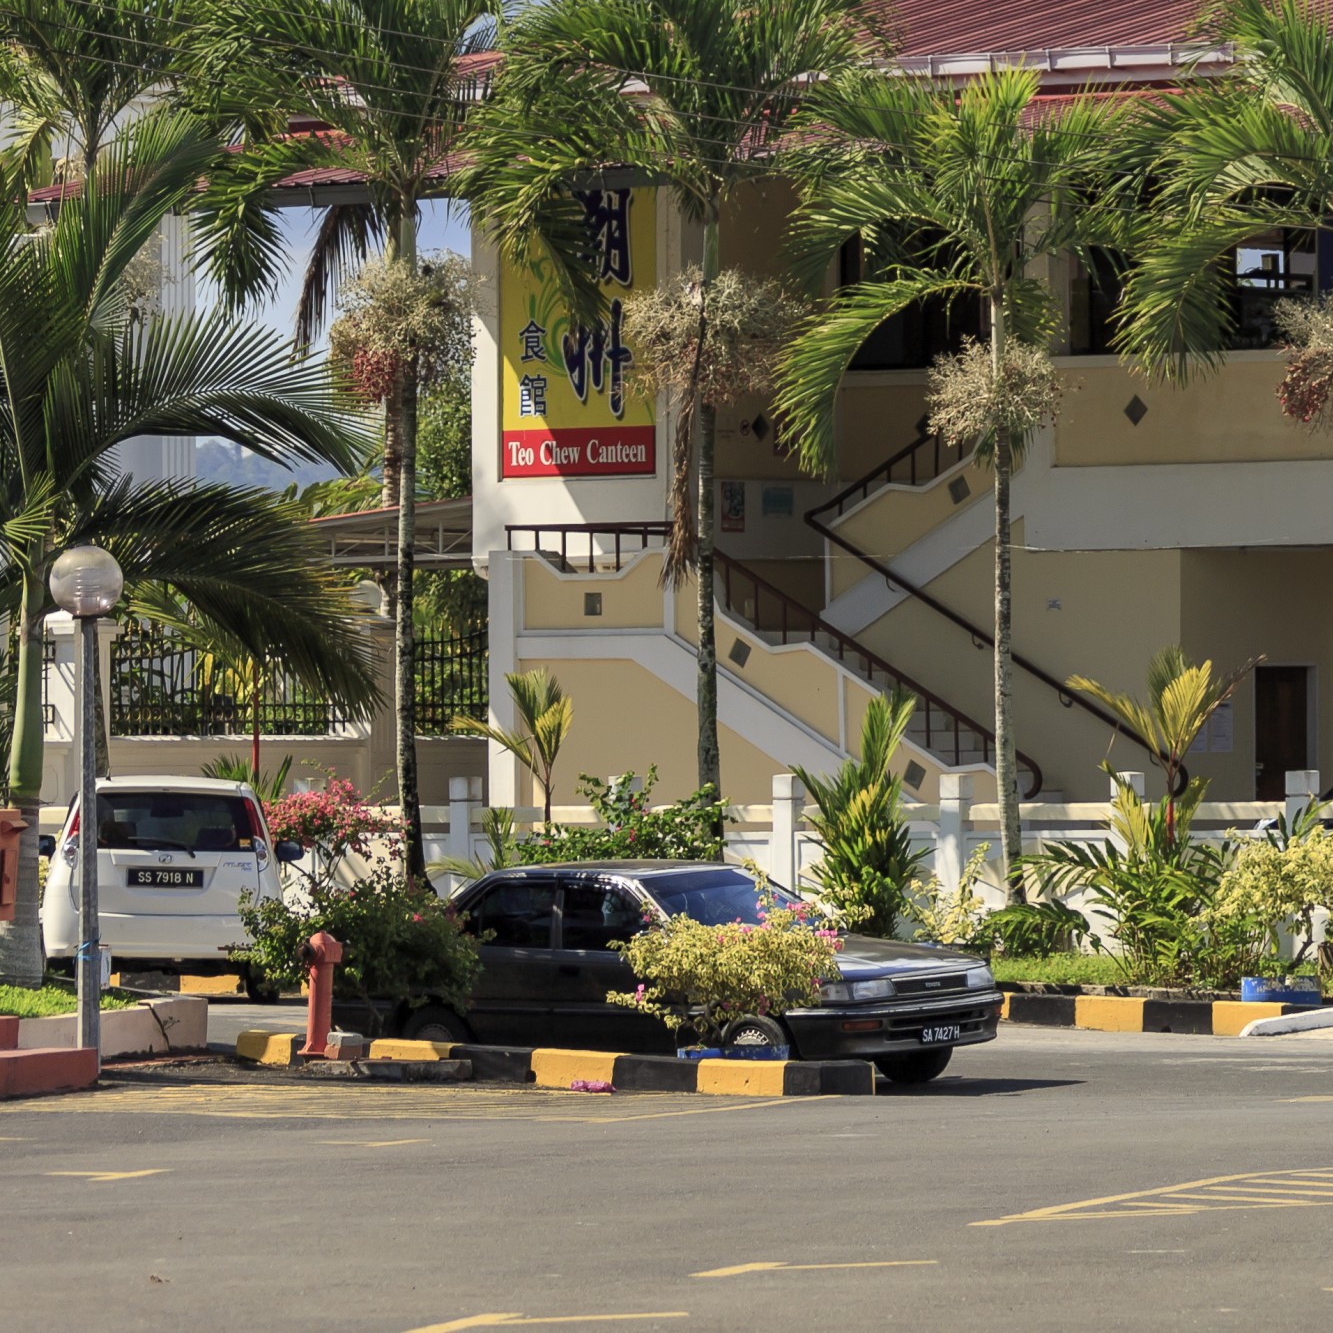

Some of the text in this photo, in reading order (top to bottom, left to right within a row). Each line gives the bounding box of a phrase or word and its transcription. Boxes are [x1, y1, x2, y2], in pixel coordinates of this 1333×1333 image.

[519, 320, 547, 417] 食館
[508, 439, 646, 466] Teo Chew Canteen
[138, 871, 194, 883] SS 7918 N
[923, 1025, 960, 1042] SA 7427 H
